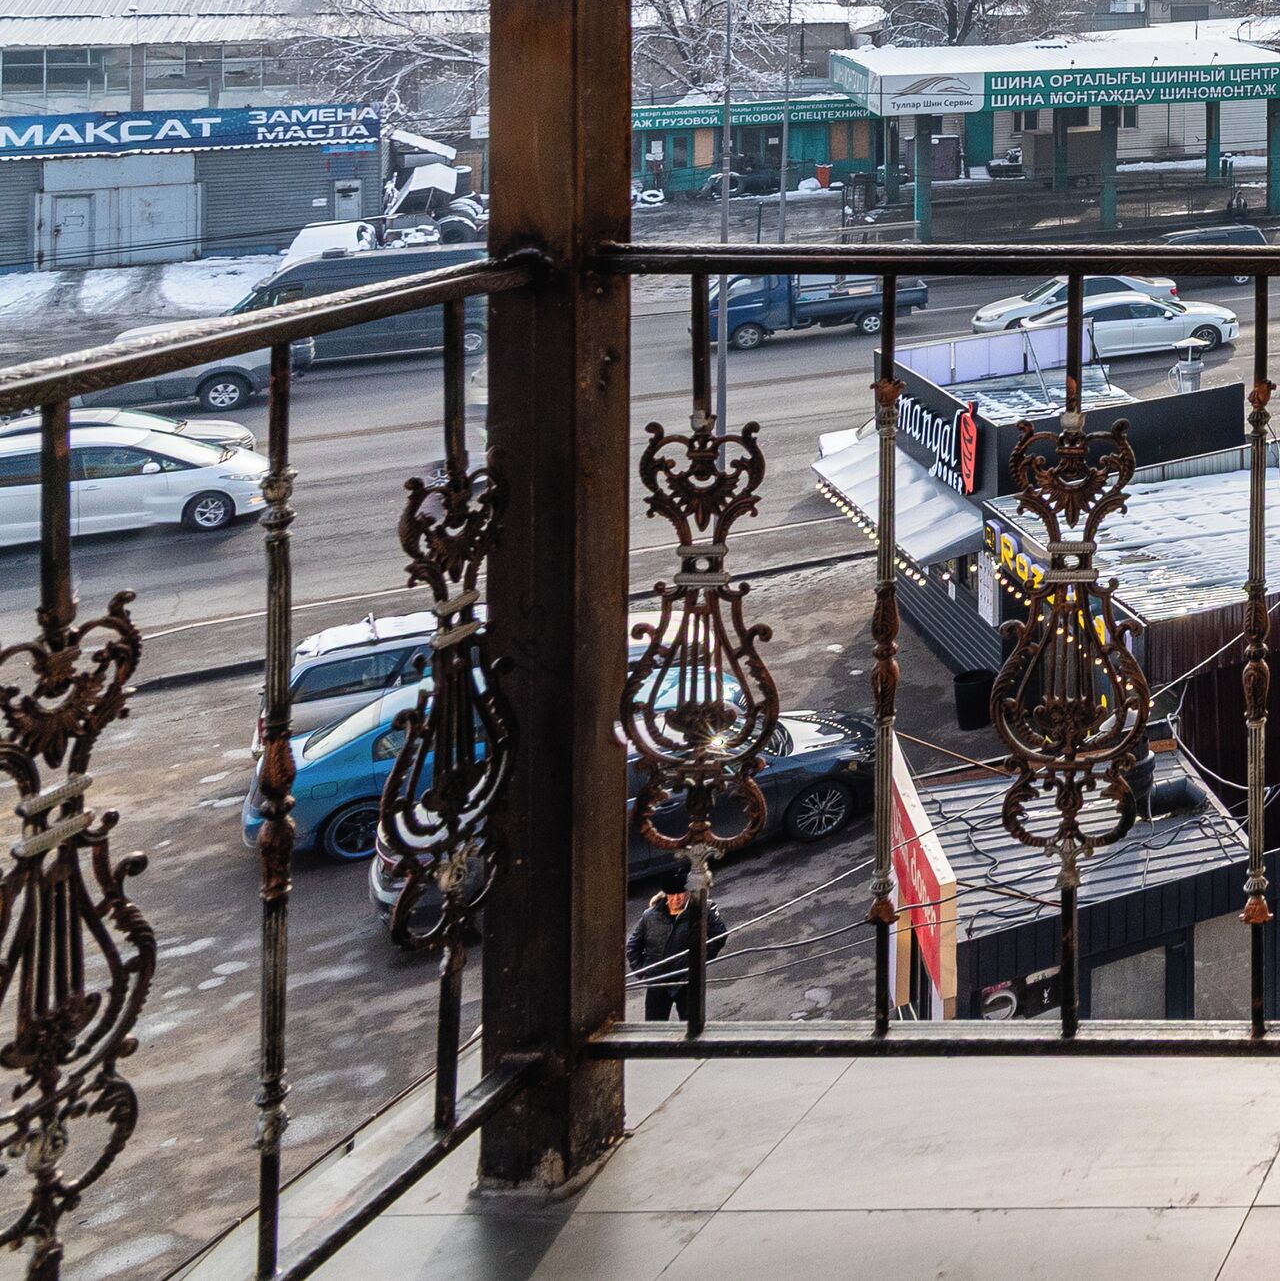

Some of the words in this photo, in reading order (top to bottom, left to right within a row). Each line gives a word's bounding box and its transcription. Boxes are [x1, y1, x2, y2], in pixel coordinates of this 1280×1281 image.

[991, 76, 1045, 90] ШИНА
[1050, 72, 1146, 87] ОРТАЛЫҒЫ
[1150, 67, 1225, 84] ШИННЫЙ
[1230, 67, 1280, 83] ЦЕНТР
[891, 101, 921, 110] Тулпар
[923, 100, 941, 108] Шин
[943, 99, 973, 109] Сервис
[991, 93, 1044, 107] ШИНА
[1050, 88, 1155, 106] МОНТАЖДАУ
[1160, 83, 1277, 100] ШИНОМОНТАЖ
[249, 107, 378, 125] ЗАМЕНА
[655, 114, 720, 127] ГРУЗОВОЙ,
[791, 109, 870, 121] СПЕЦТЕХНИКИ
[0, 117, 221, 147] МАКСАТ
[257, 123, 369, 140] МАСЛА
[897, 394, 965, 477] mangal
